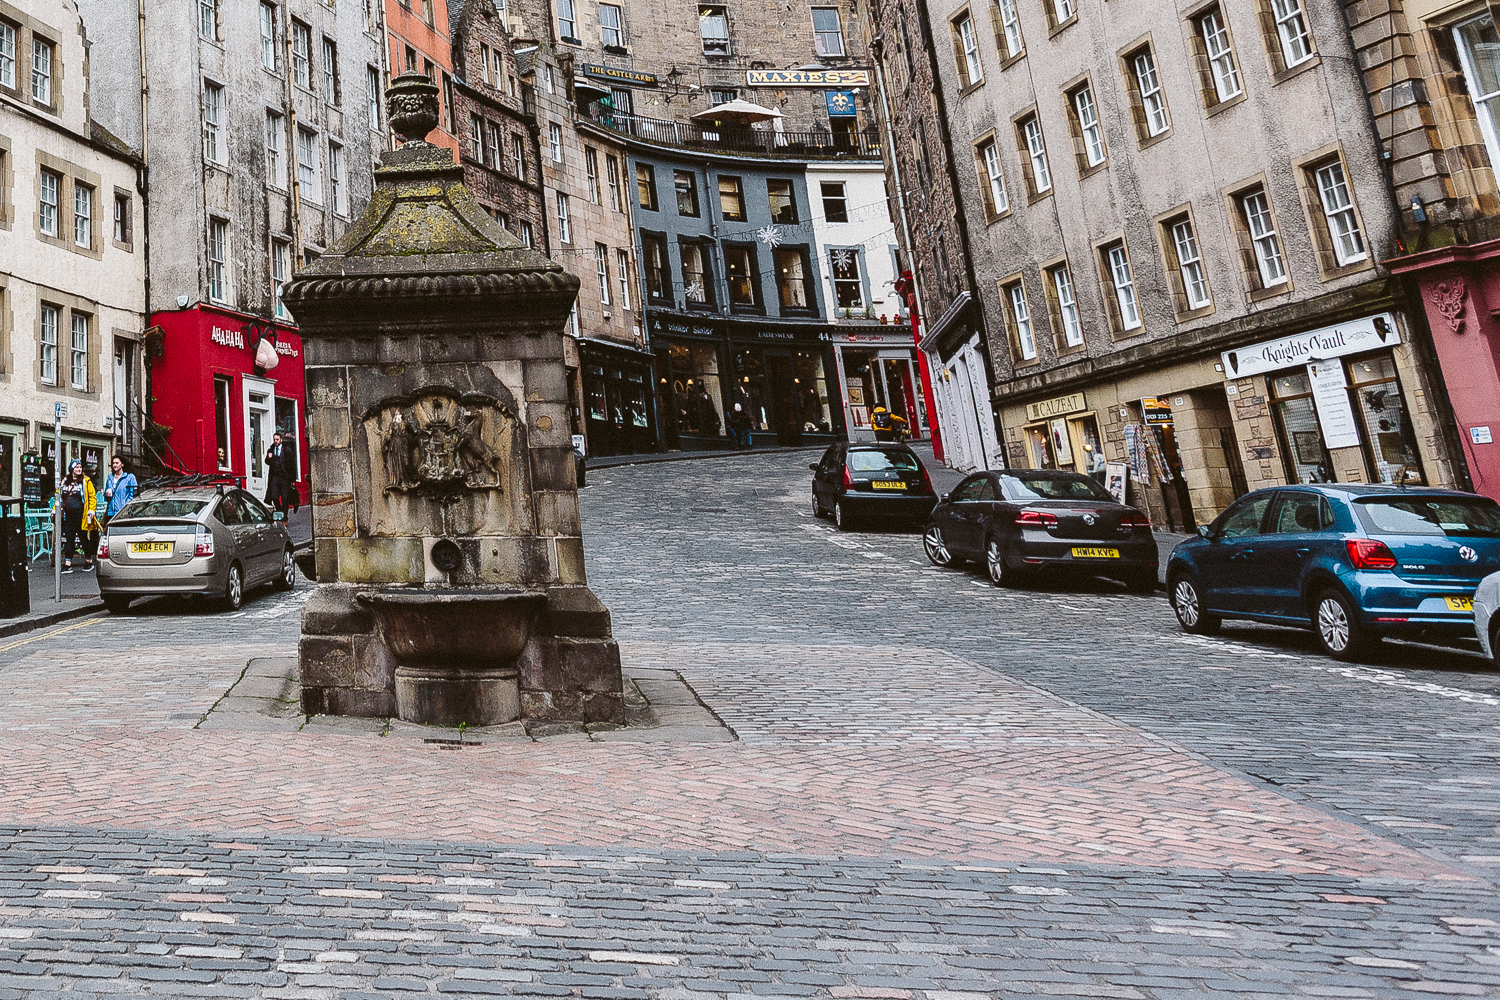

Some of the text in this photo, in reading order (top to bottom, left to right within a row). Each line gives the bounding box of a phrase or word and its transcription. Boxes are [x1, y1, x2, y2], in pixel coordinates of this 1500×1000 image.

[589, 66, 604, 75] THE
[605, 69, 633, 79] CASTLE
[751, 71, 841, 83] MAXIES
[1262, 329, 1346, 364] Knights Vault
